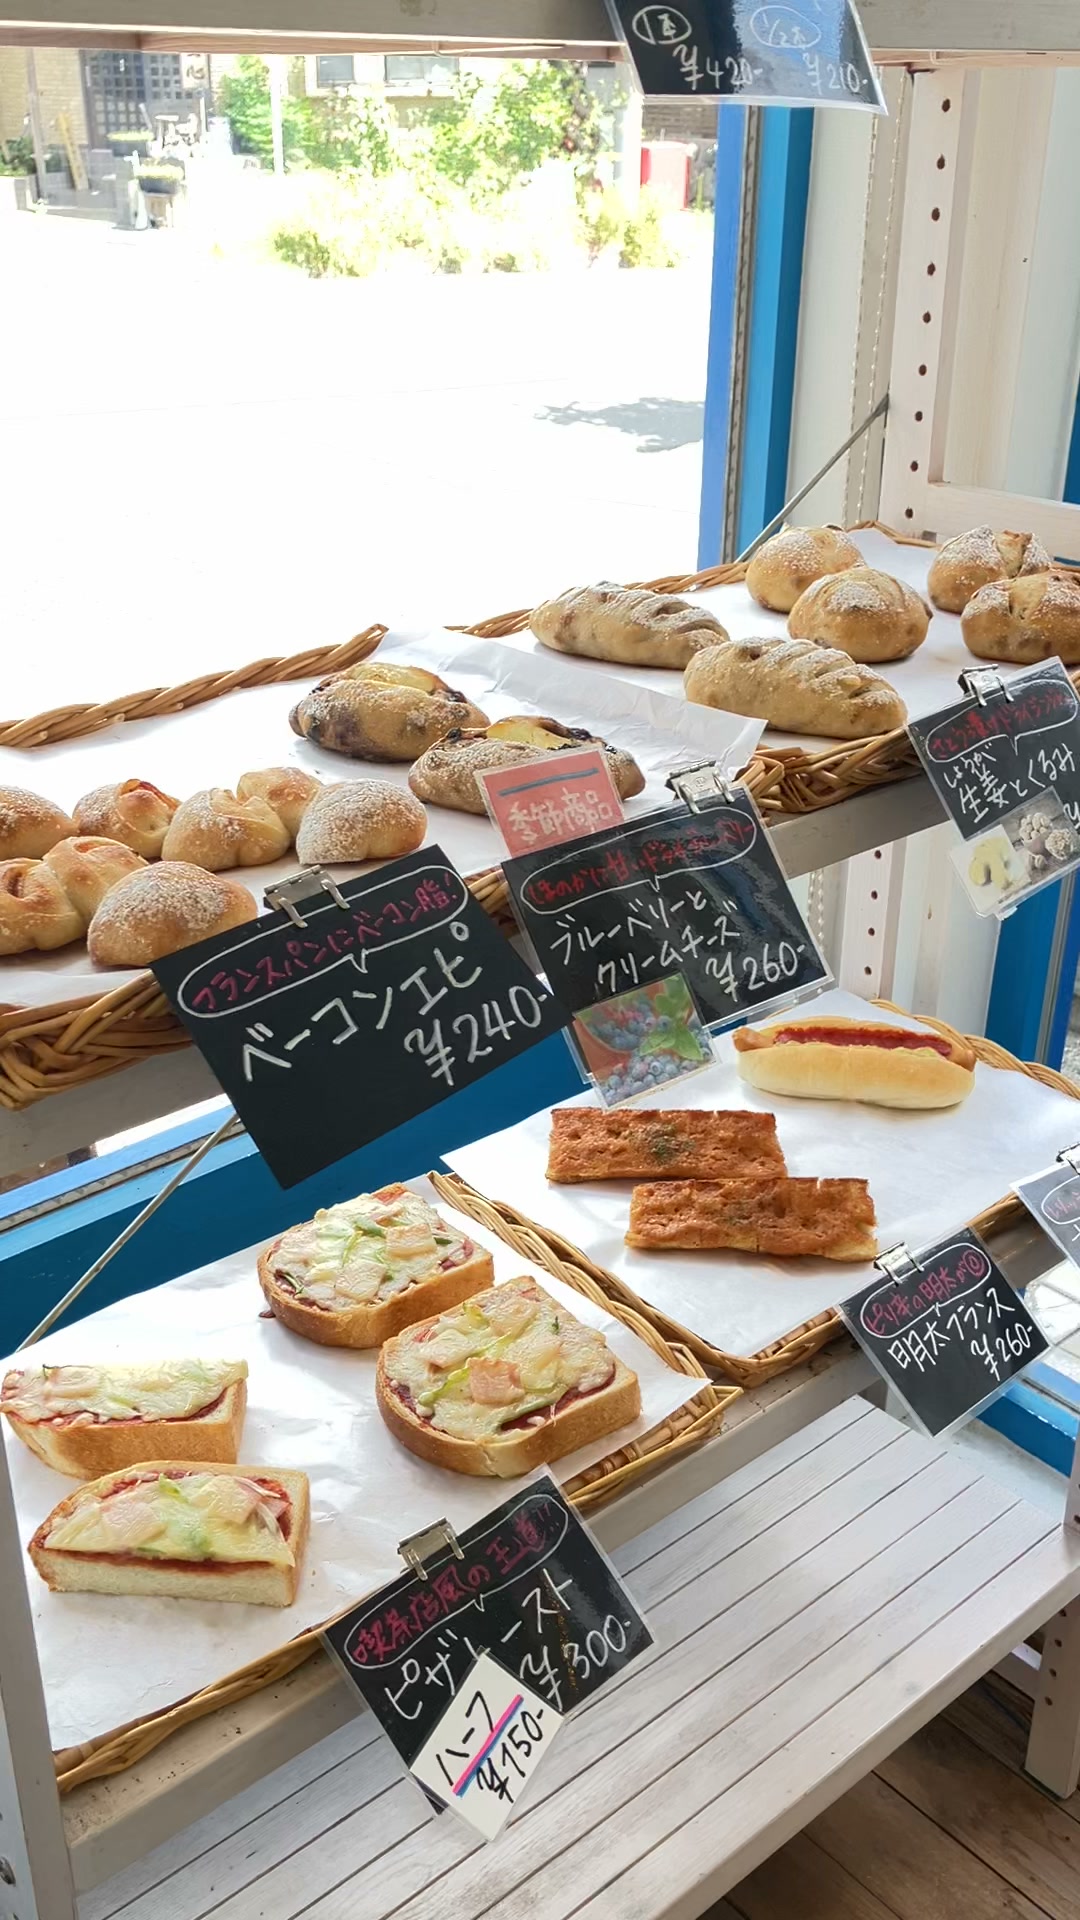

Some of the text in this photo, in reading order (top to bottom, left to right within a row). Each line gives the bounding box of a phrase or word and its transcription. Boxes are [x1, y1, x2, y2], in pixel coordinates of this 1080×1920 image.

[508, 787, 614, 845] 季節商品
[549, 891, 708, 966] ブルーベリーと
[596, 901, 742, 993] クリームチーズ
[705, 941, 807, 1003] ¥260-
[242, 920, 484, 1083] ベーコンエピ
[403, 984, 549, 1087] ¥240-
[886, 1286, 1016, 1373] 明太フランス
[970, 1325, 1034, 1382] ¥260-
[518, 1618, 633, 1713] ¥300-
[435, 1690, 495, 1787] ハーフ
[476, 1707, 546, 1804] ¥150-
